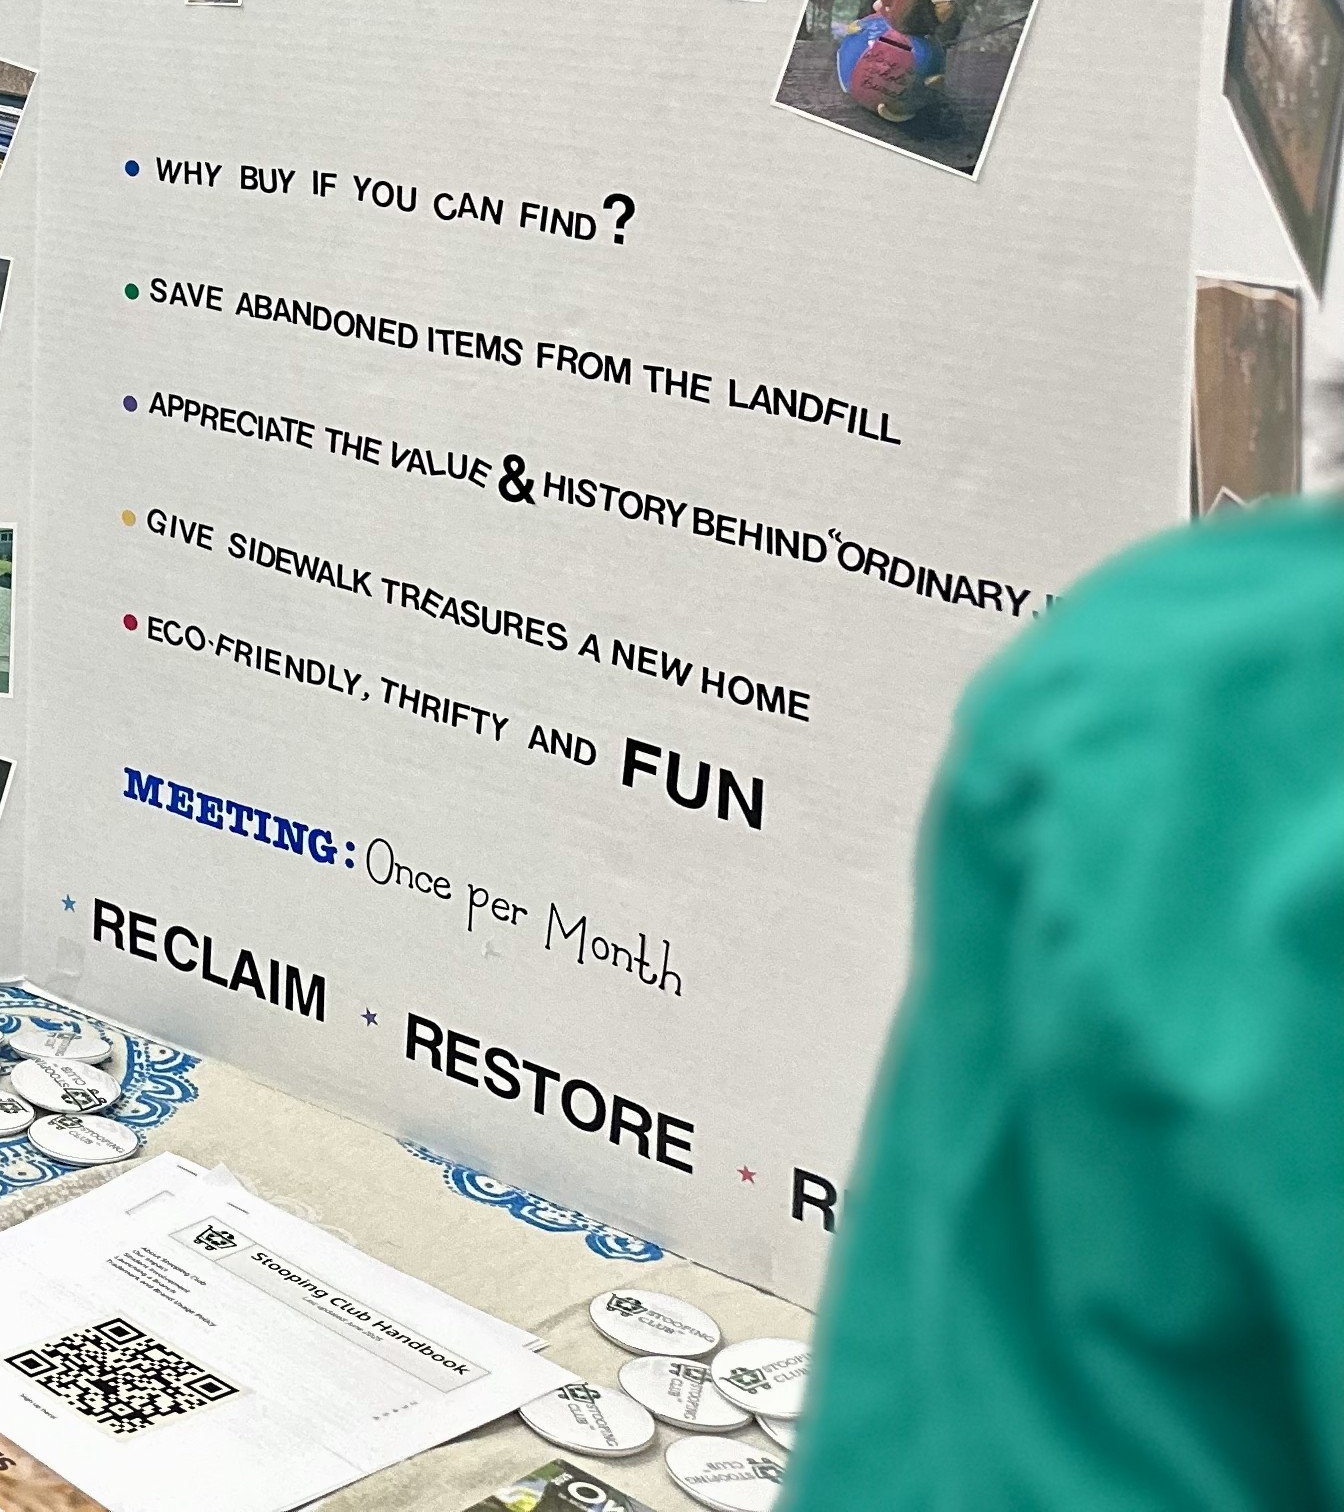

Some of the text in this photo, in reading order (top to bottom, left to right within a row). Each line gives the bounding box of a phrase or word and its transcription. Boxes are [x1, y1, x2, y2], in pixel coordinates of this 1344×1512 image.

[156, 157, 636, 245] WHY BUY IF YOU CAN FIND?
[149, 278, 902, 446] SAVE ABANDONED ITEMS FROM THE LANDFILL
[149, 392, 315, 449] APPRECIATE
[325, 428, 382, 465] THE
[391, 441, 492, 488] VALUE
[498, 454, 536, 505] &
[542, 472, 687, 529] HISTORY
[692, 507, 827, 563] BEHIND
[147, 508, 810, 723] GIVE SIDEWALK TREASURES A NEW HOME
[147, 616, 764, 831] ECO-FRIENDLY, THRIFTY AND FUN
[123, 767, 683, 996] MEETING: Once per Month
[93, 898, 326, 1022] RECLAIM
[405, 1012, 695, 1175] RESTORE
[68, 1129, 93, 1145] CLUB
[80, 1126, 125, 1153] STOOPING
[251, 1252, 471, 1375] Stooping Club Handbook
[638, 1316, 675, 1335] CLUB
[646, 1309, 716, 1343] STOOPING
